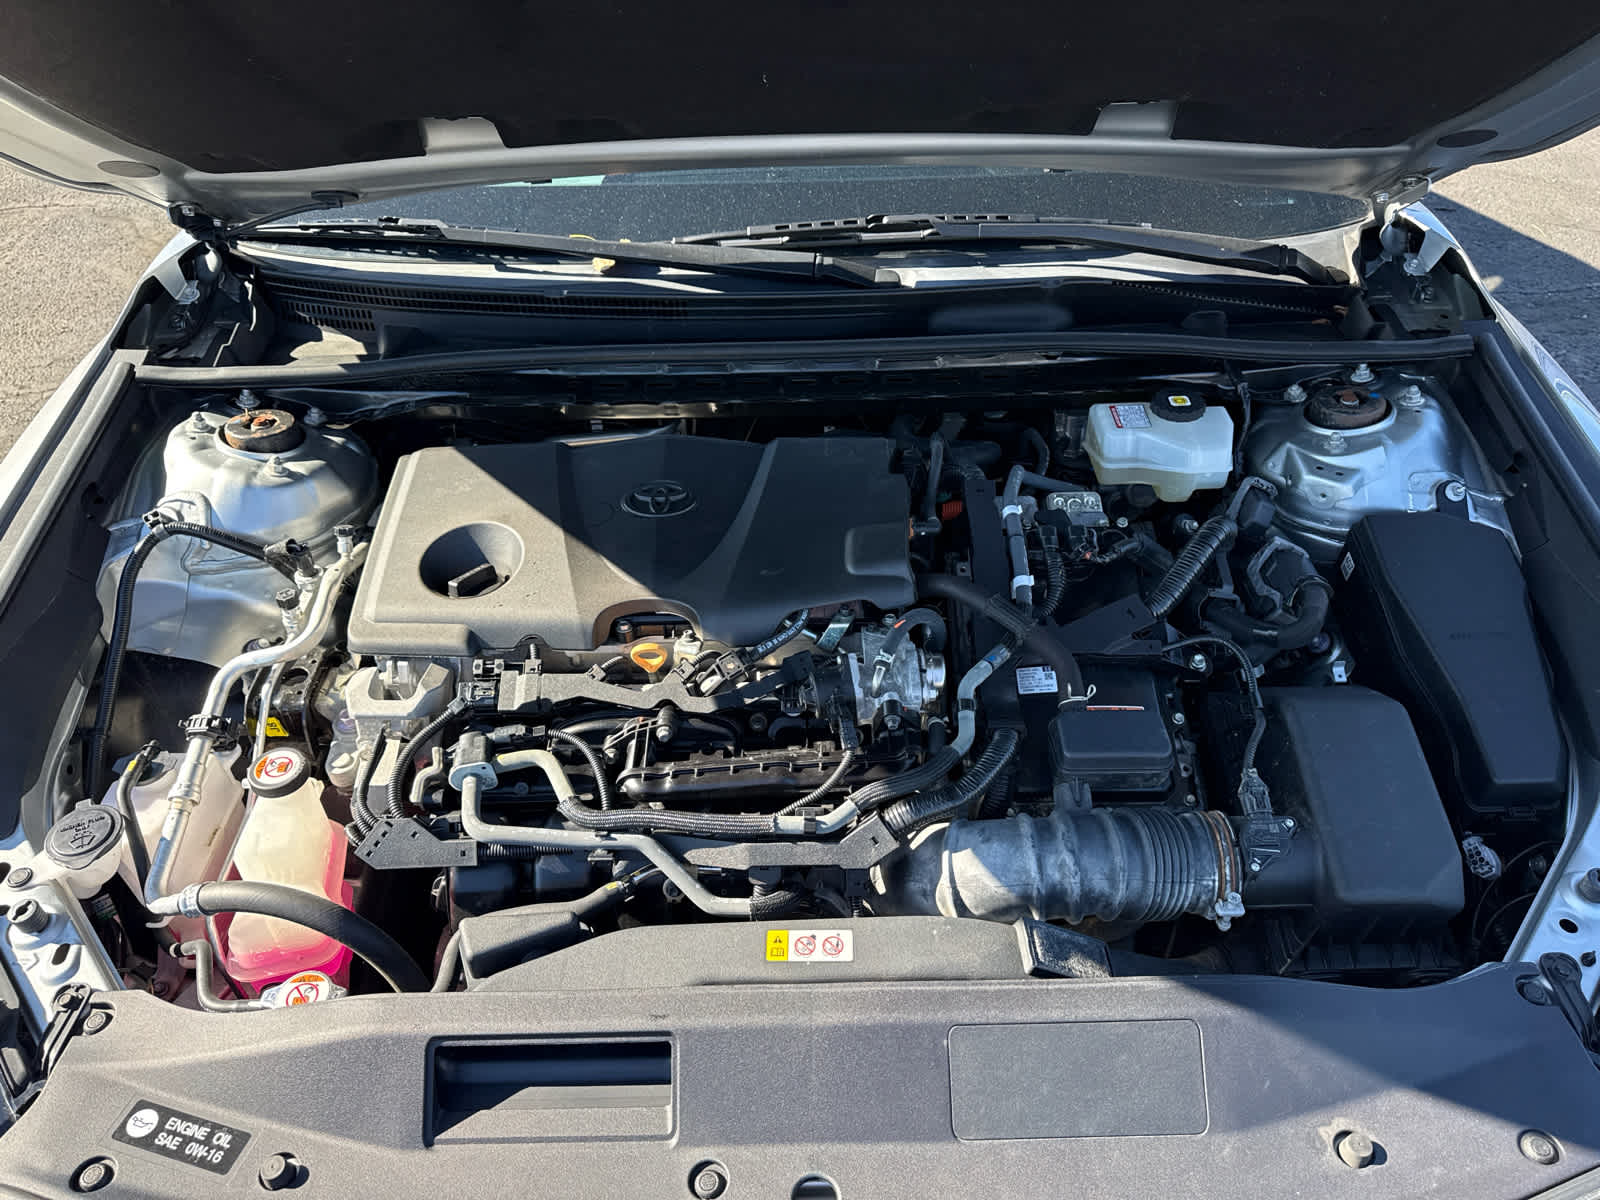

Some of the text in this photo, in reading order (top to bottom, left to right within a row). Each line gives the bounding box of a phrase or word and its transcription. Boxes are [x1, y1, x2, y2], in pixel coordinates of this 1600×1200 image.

[154, 1132, 224, 1163] SAE 0W-16
[165, 1117, 233, 1149] ENGINE OIL
